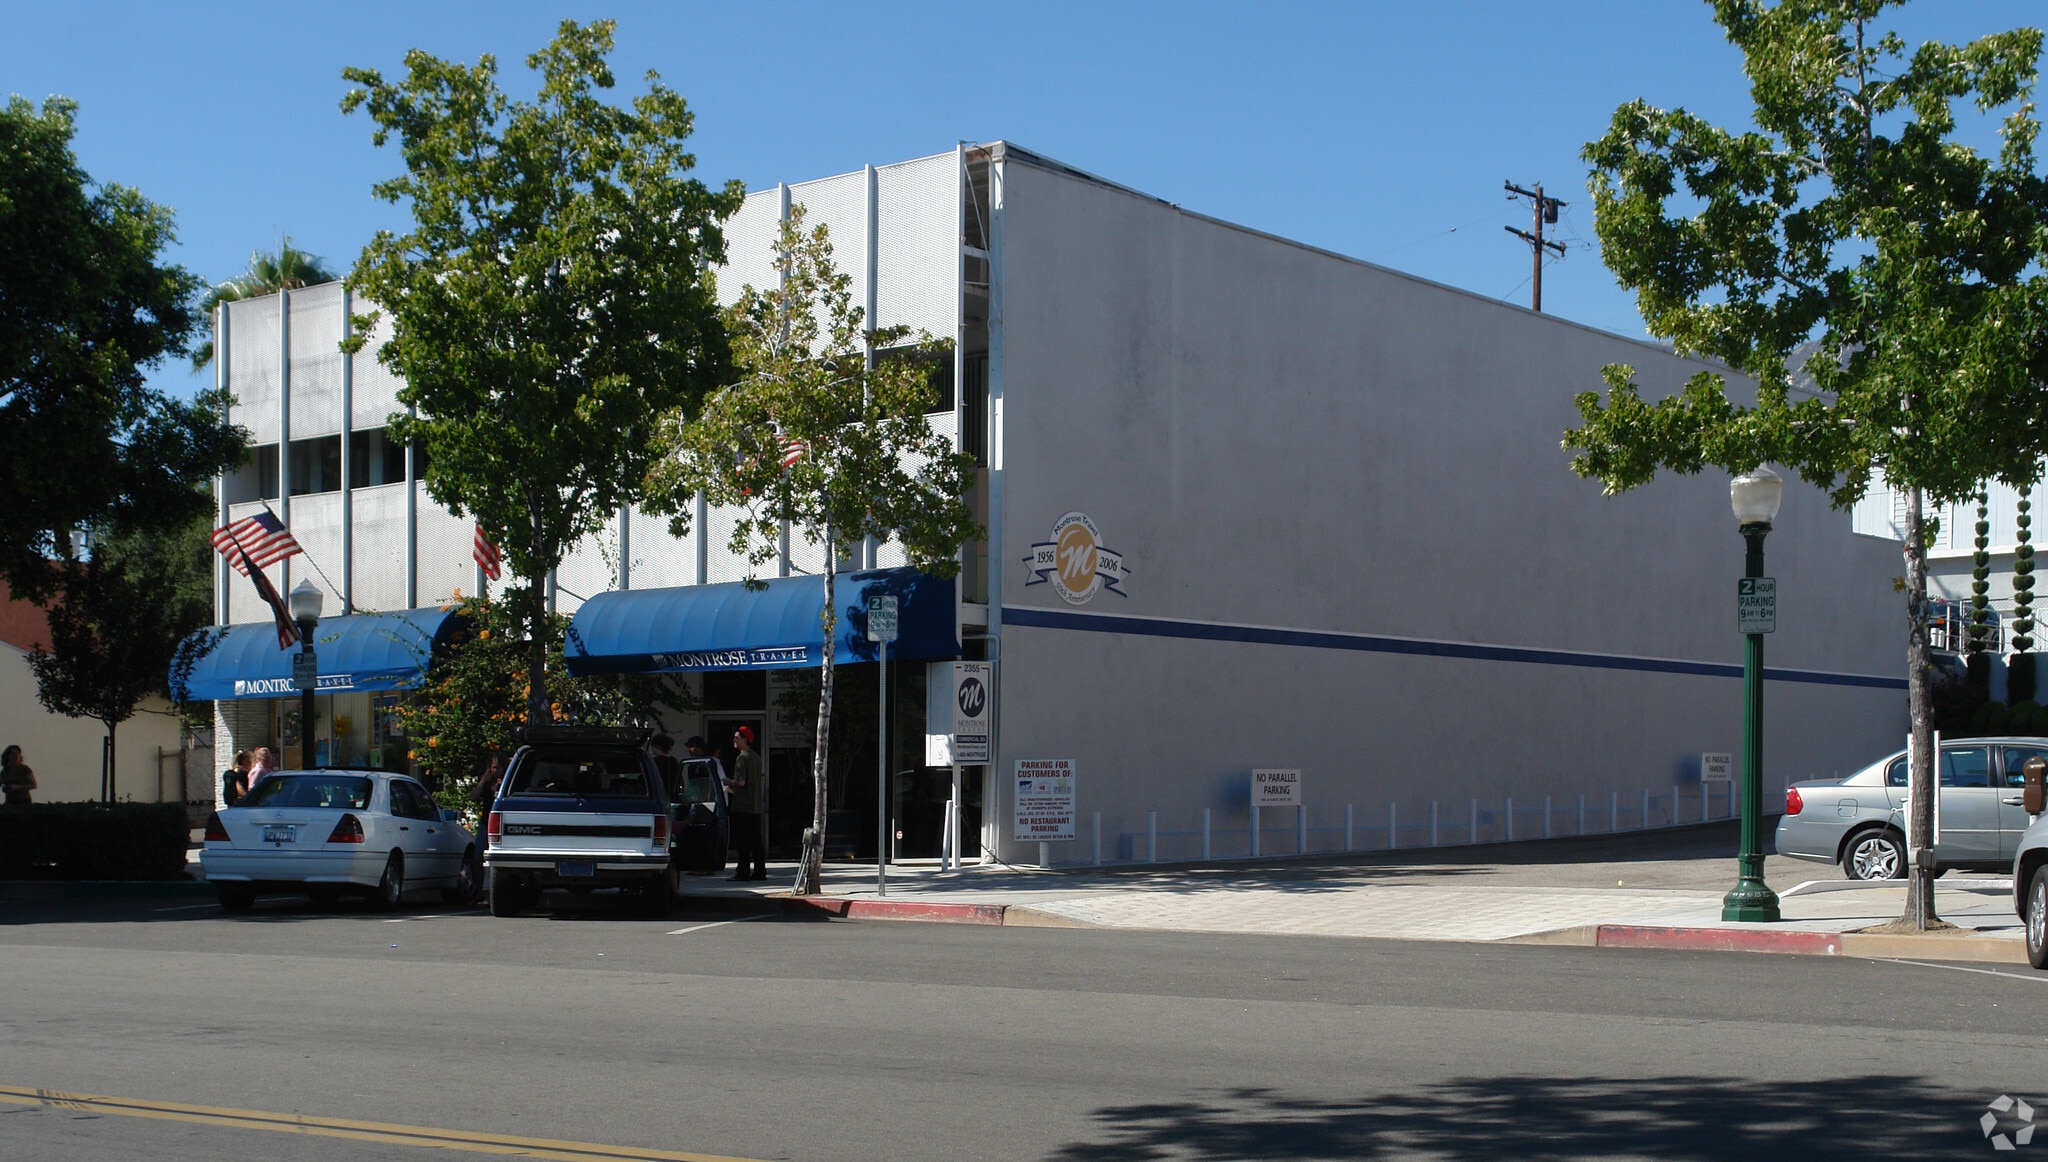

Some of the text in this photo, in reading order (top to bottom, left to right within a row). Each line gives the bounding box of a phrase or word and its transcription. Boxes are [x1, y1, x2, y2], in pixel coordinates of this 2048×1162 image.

[1054, 515, 1098, 537] Montrose Travel
[1037, 551, 1054, 563] 1956
[1099, 557, 1118, 571] 2006
[1742, 581, 1774, 594] 2 HOUR
[871, 598, 880, 609] 2
[1740, 596, 1774, 607] PARKING
[870, 611, 896, 619] PARKING
[668, 650, 748, 667] MONTROSE
[963, 664, 980, 672] 2355
[246, 678, 300, 694] MONTRO
[1021, 761, 1069, 769] PARKING FOR
[1017, 770, 1060, 778] CUSTOMERS
[1256, 773, 1297, 782] NO PARALLEL
[1263, 785, 1291, 795] PARKING
[1030, 817, 1070, 825] RESTAURANT
[507, 826, 542, 834] GMC
